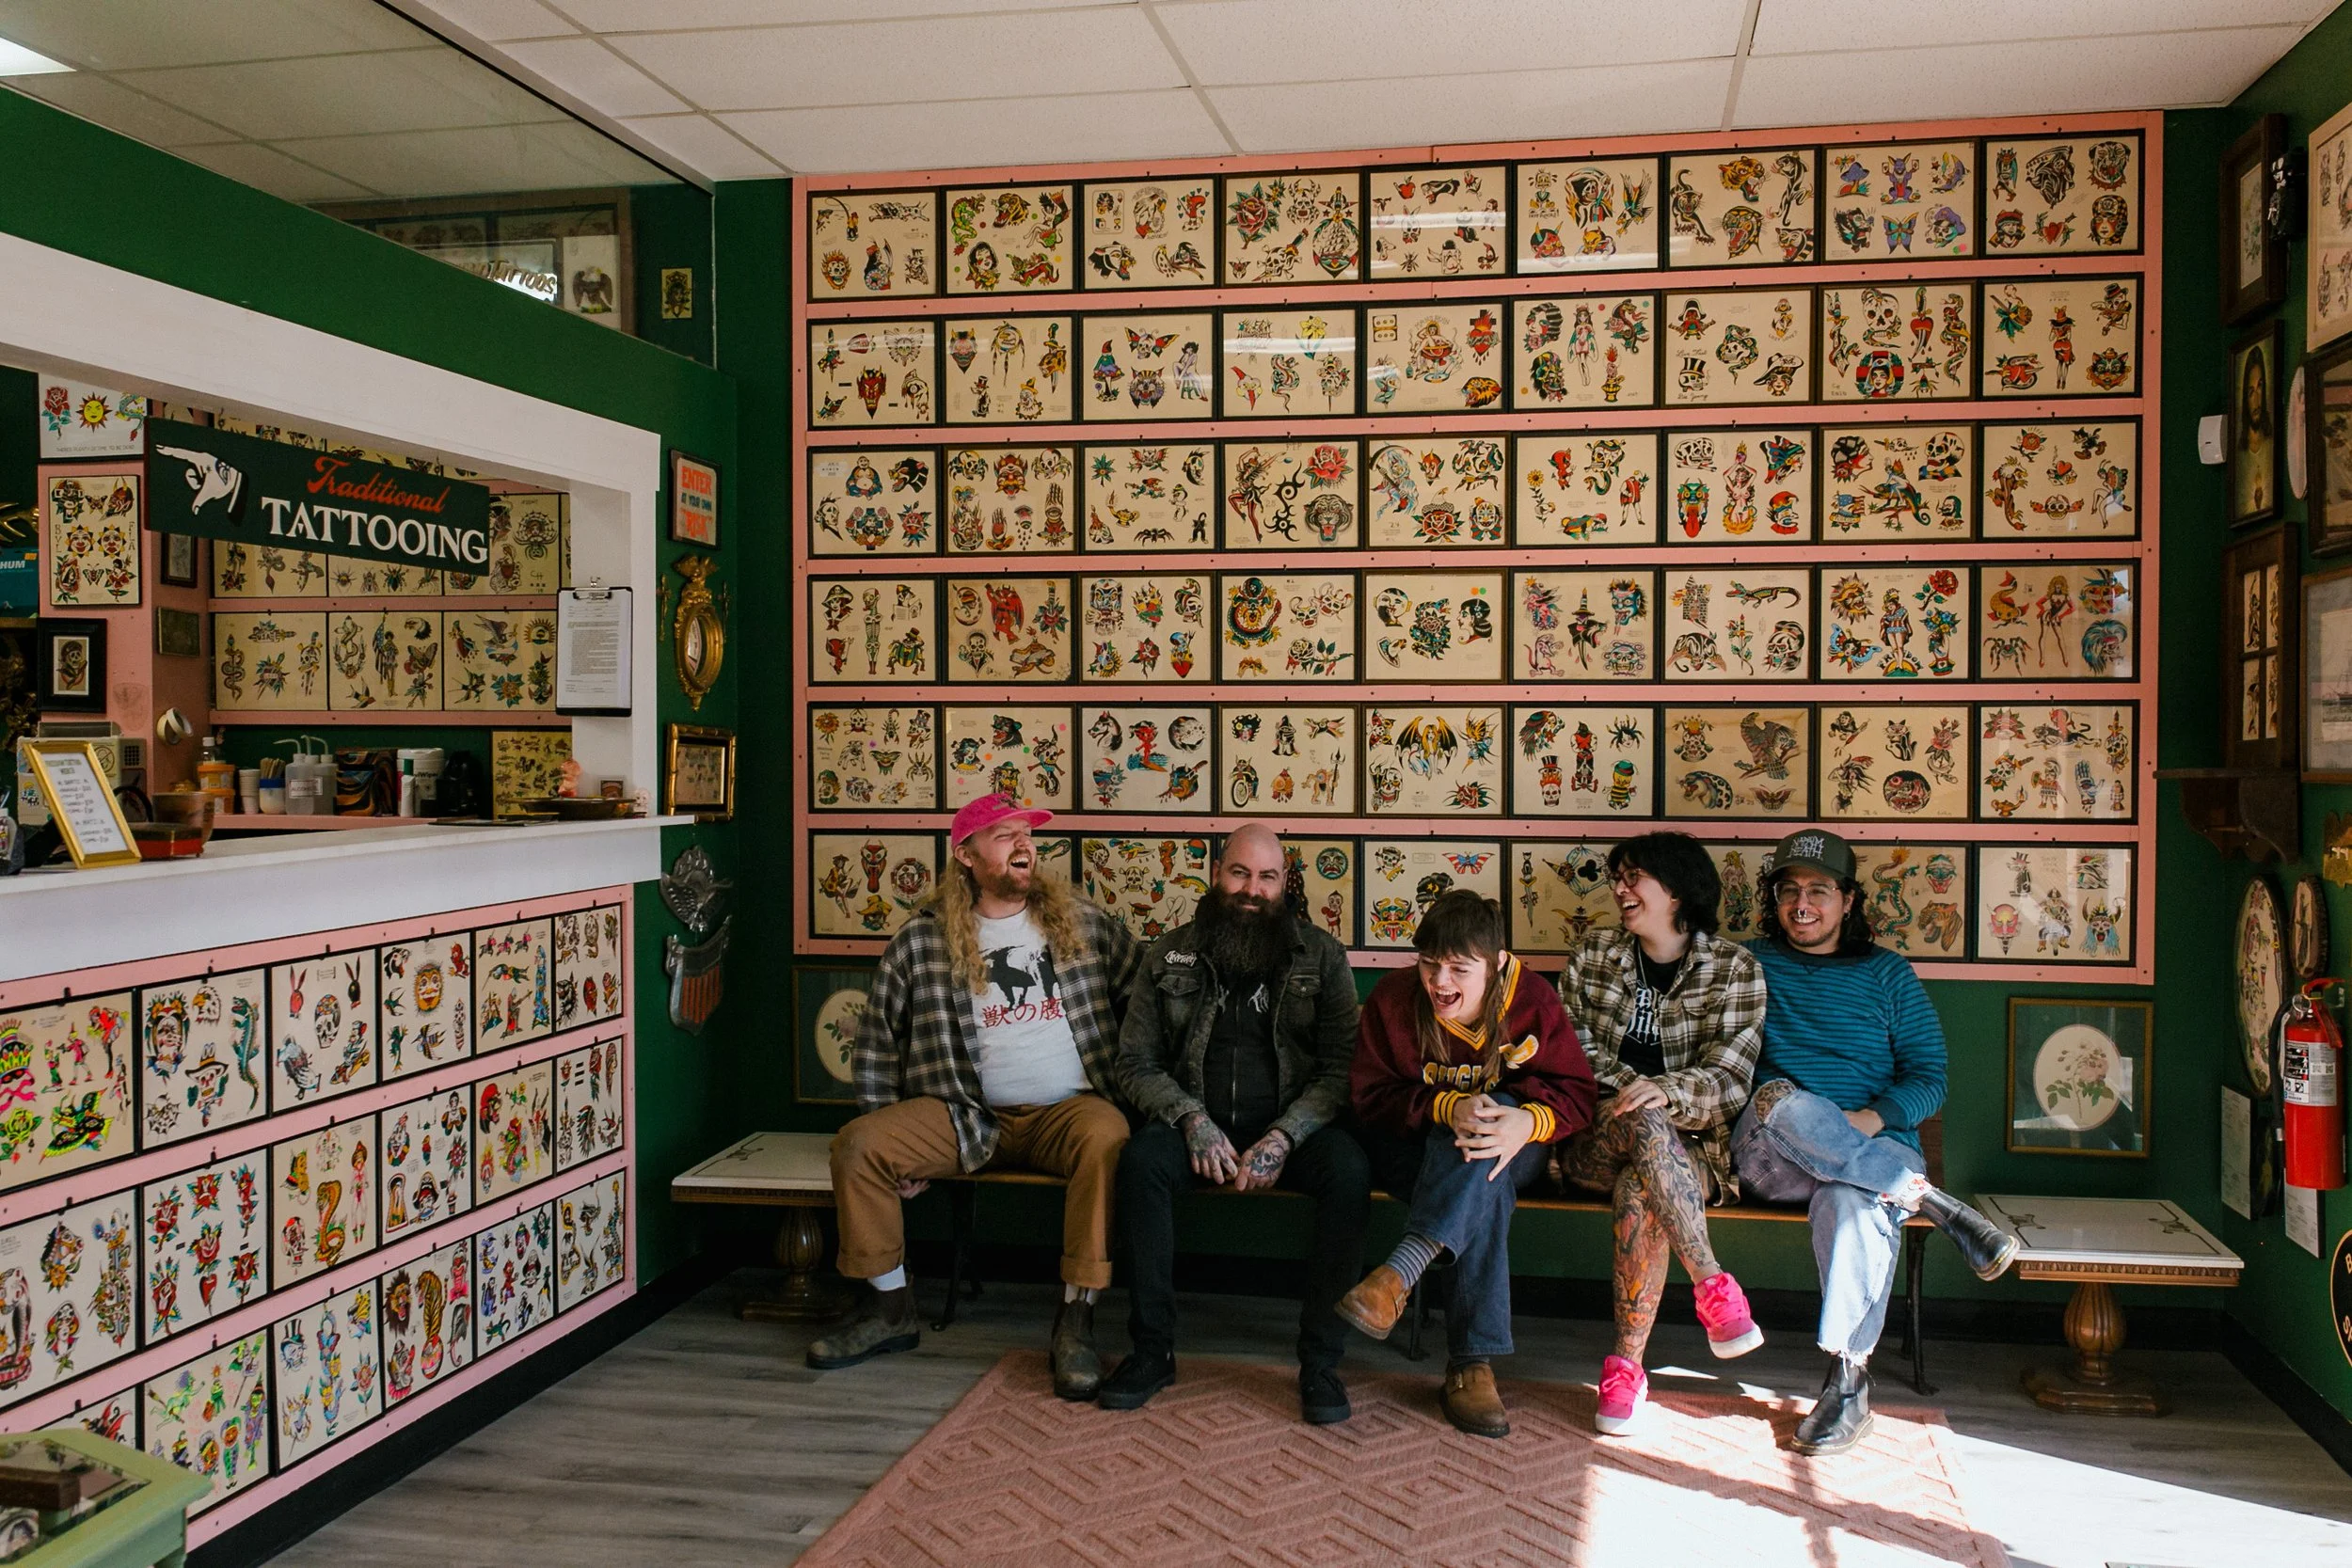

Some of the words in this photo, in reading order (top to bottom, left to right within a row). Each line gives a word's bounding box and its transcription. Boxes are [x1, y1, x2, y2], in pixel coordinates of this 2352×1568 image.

[307, 455, 451, 514] Traditional
[680, 465, 712, 496] ENTER
[261, 496, 488, 564] TATTOOING
